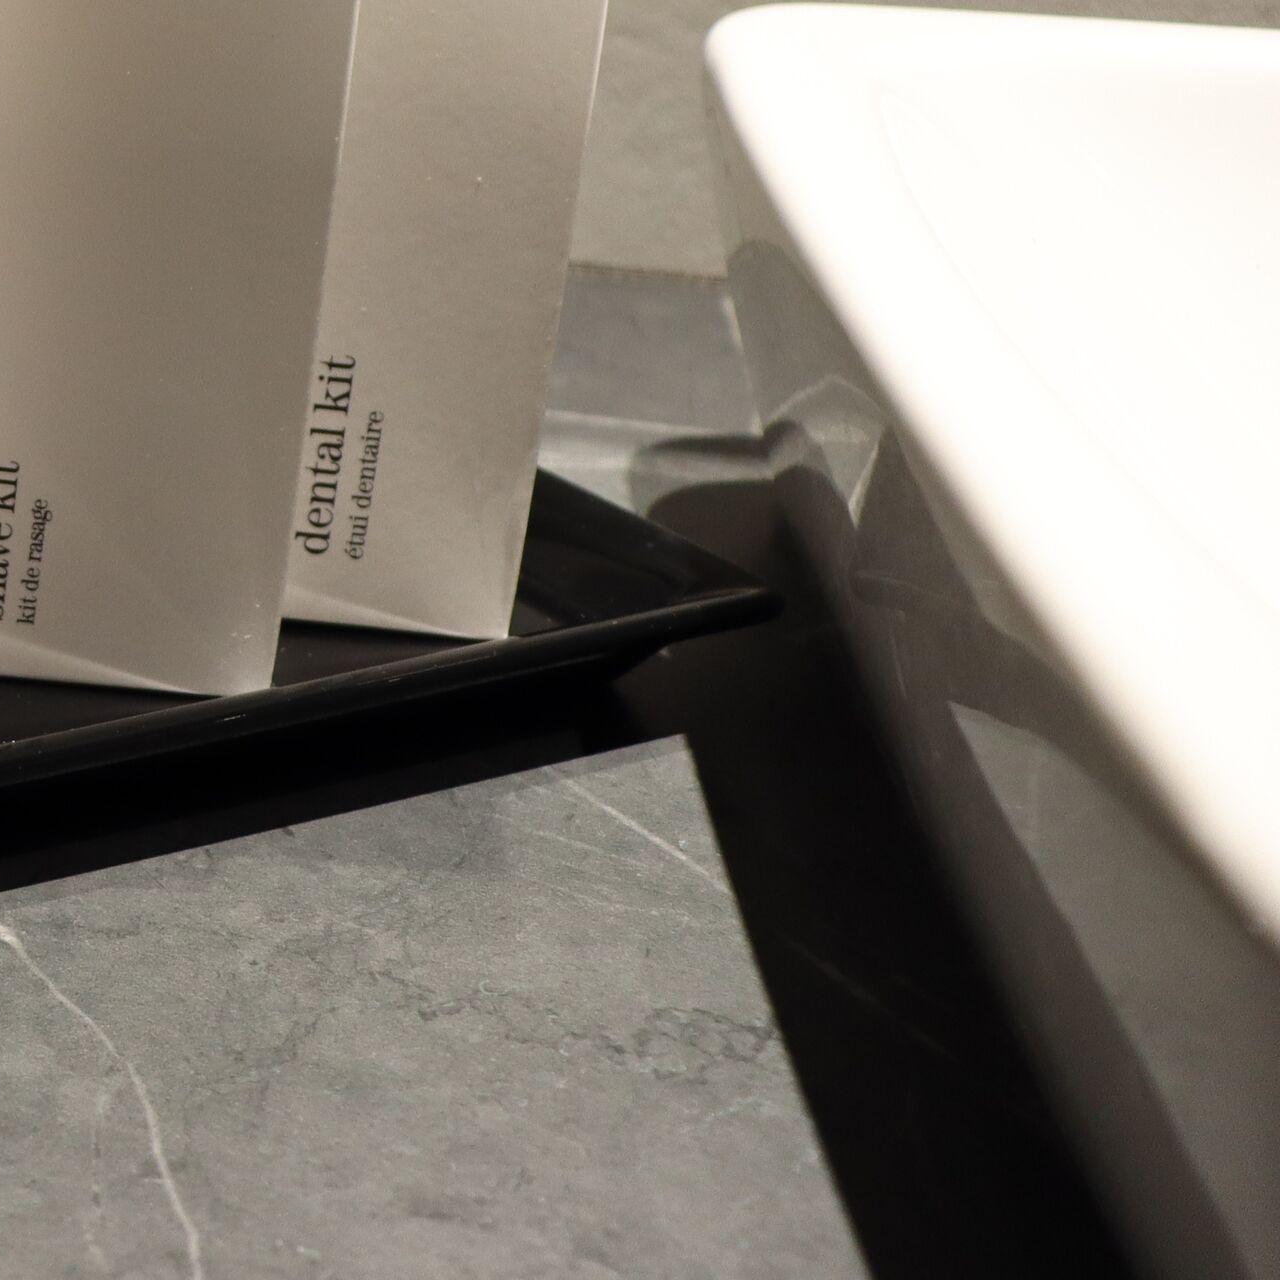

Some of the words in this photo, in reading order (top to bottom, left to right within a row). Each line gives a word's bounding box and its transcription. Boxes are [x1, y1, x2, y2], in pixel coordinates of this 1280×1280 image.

[314, 354, 356, 416] kit
[295, 426, 346, 556] dental
[352, 410, 385, 510] dentaire
[28, 499, 53, 562] rasage
[345, 516, 369, 560] étui
[17, 595, 37, 625] kit
[21, 567, 40, 592] de
